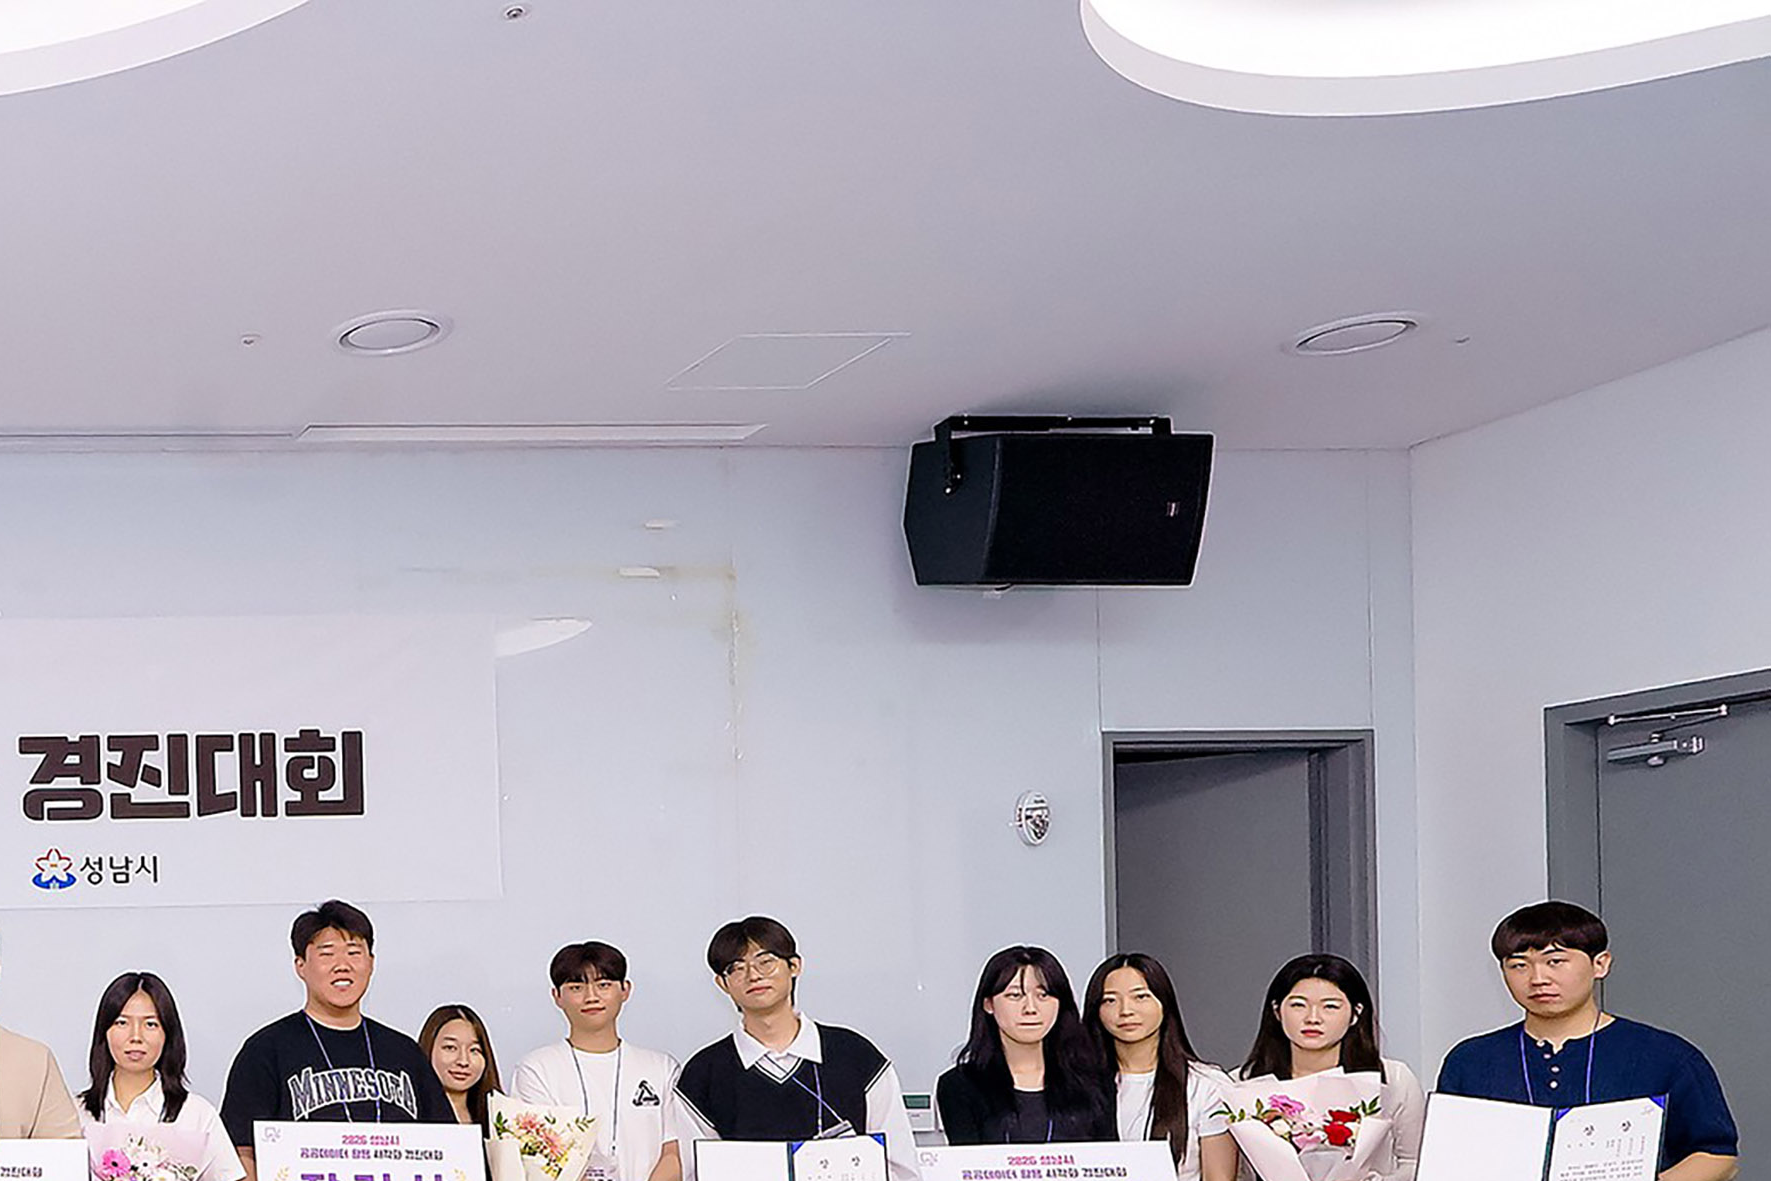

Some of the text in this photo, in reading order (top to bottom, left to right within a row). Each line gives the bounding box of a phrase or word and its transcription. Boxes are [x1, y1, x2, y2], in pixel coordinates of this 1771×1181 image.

[19, 729, 364, 822] 경진대회
[80, 856, 159, 885] 성남시
[287, 1066, 418, 1121] MINNESOTA
